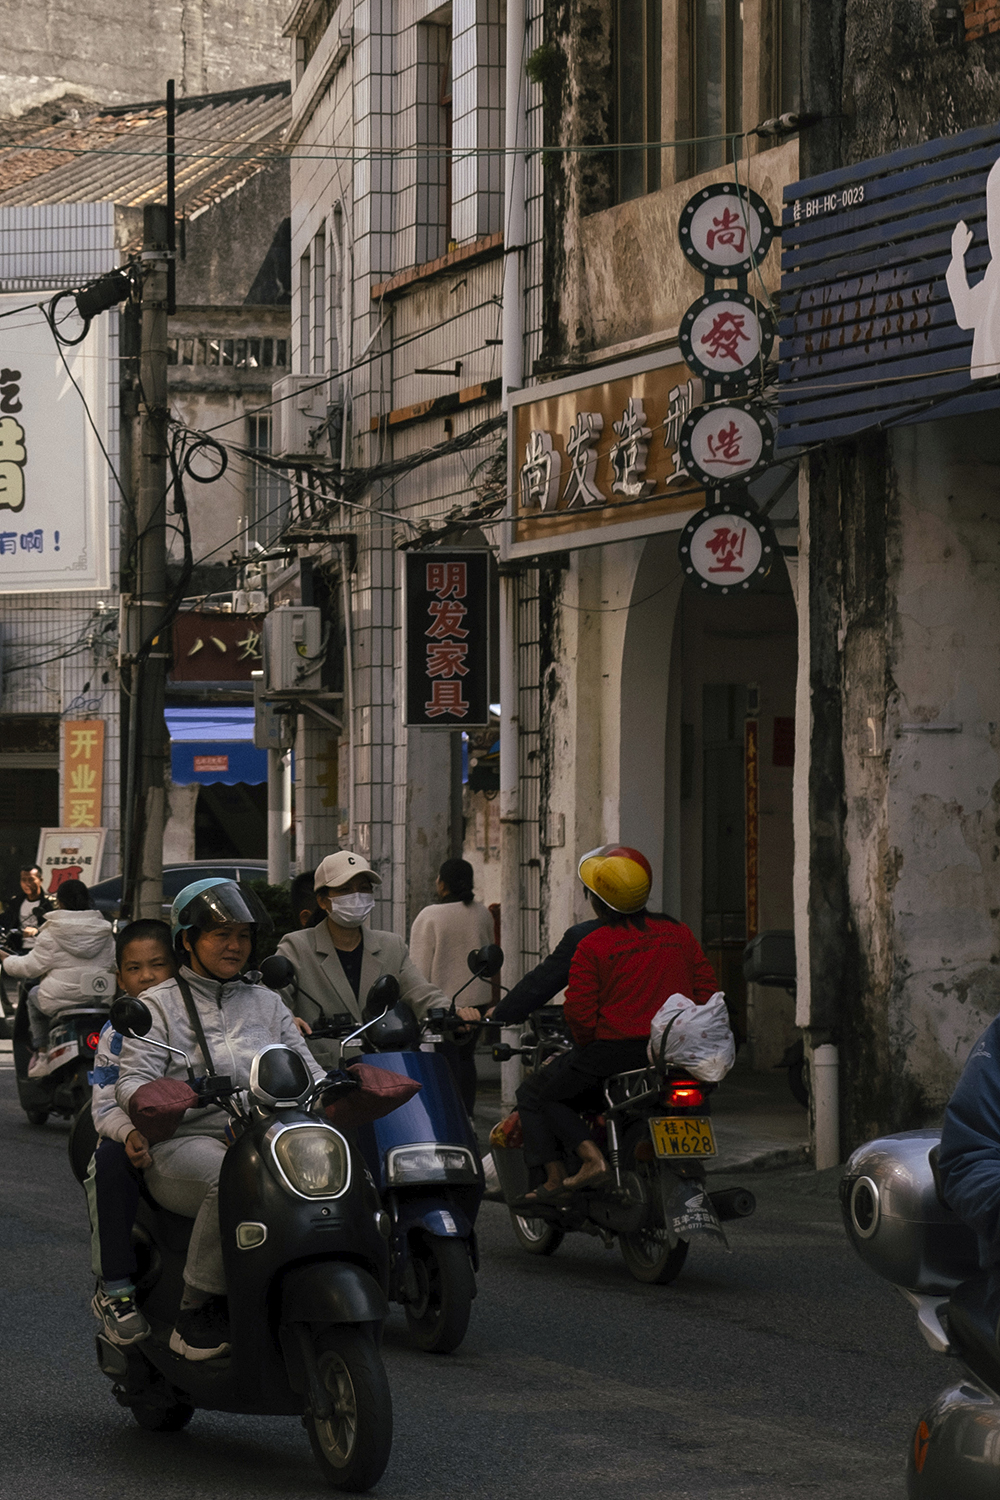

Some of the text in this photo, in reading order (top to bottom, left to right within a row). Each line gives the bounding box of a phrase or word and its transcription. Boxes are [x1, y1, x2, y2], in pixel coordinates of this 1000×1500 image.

[424, 562, 470, 718] 明发家具
[347, 856, 356, 865] C
[661, 1136, 712, 1153] 1W628
